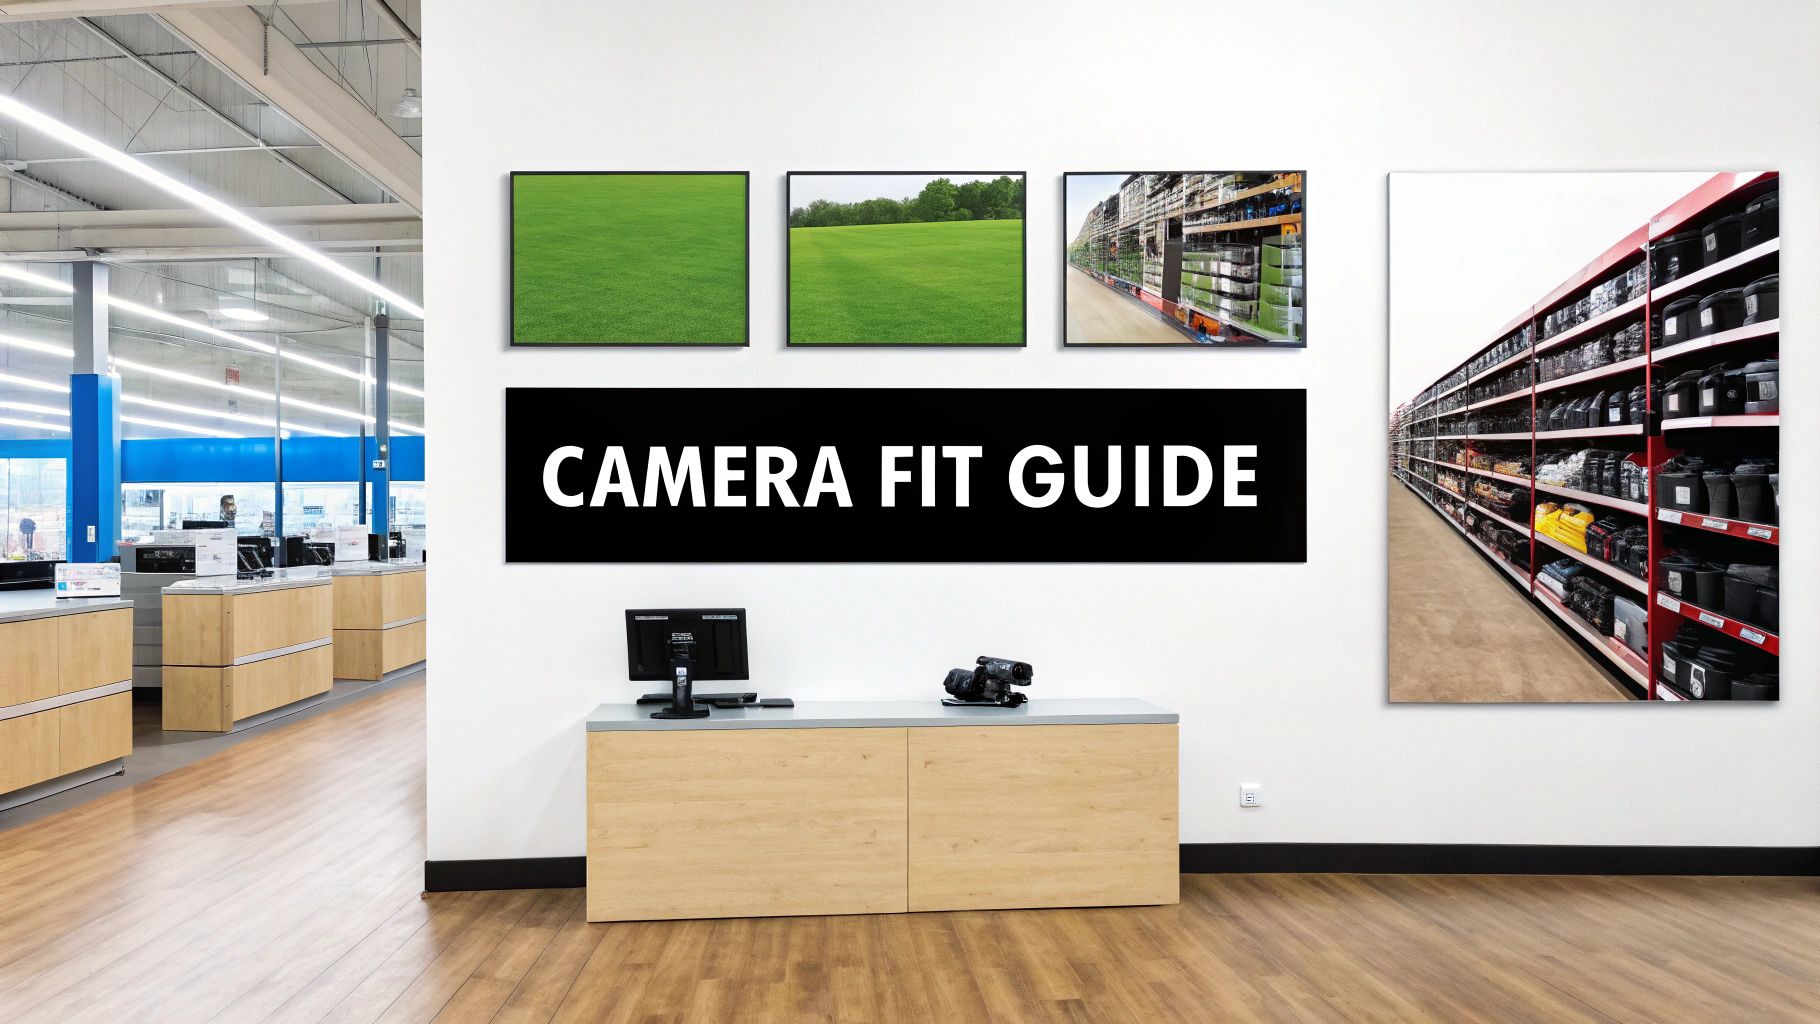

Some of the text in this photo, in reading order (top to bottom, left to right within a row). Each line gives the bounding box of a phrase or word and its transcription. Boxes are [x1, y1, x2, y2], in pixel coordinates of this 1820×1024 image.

[542, 444, 1259, 508] CAMERA FIT GUIDE
